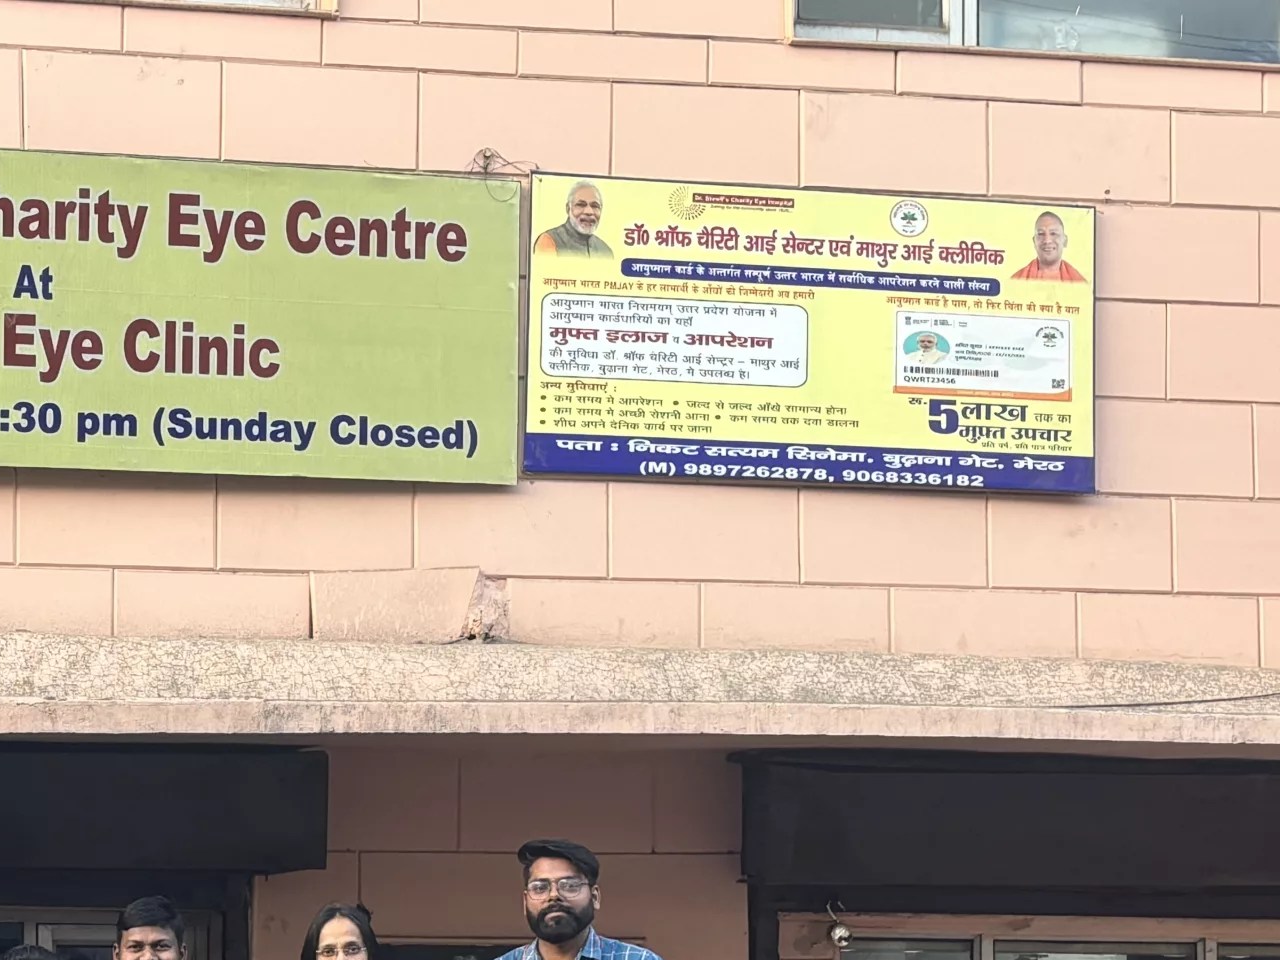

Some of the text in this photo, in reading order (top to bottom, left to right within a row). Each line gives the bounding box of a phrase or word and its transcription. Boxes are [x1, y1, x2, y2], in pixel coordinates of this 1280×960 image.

[168, 193, 265, 263] Eye
[286, 200, 467, 262] Centre
[654, 224, 692, 247] श्रॉफ
[696, 225, 740, 251] चैरिटी
[743, 229, 777, 255] आई
[781, 230, 826, 256] सेन्टर
[827, 234, 854, 257] एवं
[855, 241, 898, 268] माथुर
[900, 241, 934, 264] आई
[938, 240, 1005, 265] क्लीनिक
[13, 265, 53, 300] At
[579, 279, 601, 288] भारत
[646, 283, 657, 292] हर
[631, 263, 672, 276] आयुष्मान
[674, 264, 694, 275] कार्ड
[695, 264, 705, 275] के
[708, 266, 741, 278] अन्तर्गत
[800, 272, 824, 282] भारत
[827, 271, 836, 282] में
[877, 275, 917, 287] आपरेशन
[918, 277, 940, 288] करने
[942, 278, 965, 289] वाली
[967, 279, 990, 291] संस्था
[549, 298, 594, 311] आयुष्मान
[598, 300, 624, 310] भारत
[702, 304, 729, 315] प्रदेश
[732, 305, 765, 317] योजना
[549, 311, 594, 324] आयुष्मान
[656, 316, 670, 326] का
[4, 313, 103, 383] Eye
[124, 319, 280, 378] Clinic
[604, 329, 669, 344] इलाज
[683, 331, 774, 349] आपरेशन
[548, 346, 563, 357] की
[681, 352, 702, 365] आई
[749, 358, 776, 370] माथुर
[779, 357, 800, 370] आई
[539, 381, 562, 390] अन्य
[903, 375, 956, 384] QWRT23456
[553, 394, 572, 403] कम
[575, 395, 602, 404] समय
[618, 395, 663, 407] आपरेशन
[825, 404, 847, 415] होना
[552, 407, 572, 415] कम
[575, 407, 602, 416] समय
[685, 412, 709, 421] आना
[729, 414, 748, 423] कम
[751, 415, 777, 424] समय
[825, 418, 859, 428] डालना
[928, 398, 959, 434] 5
[960, 401, 1028, 422] लाख
[1033, 412, 1053, 423] तक
[1056, 414, 1071, 424] का
[77, 412, 137, 442] pm
[153, 407, 316, 451] (Sunday
[330, 415, 477, 458] Closed)
[669, 424, 683, 432] पर
[686, 425, 712, 433] जाना
[1010, 427, 1072, 442] उपचार
[555, 439, 603, 451] पता
[627, 438, 700, 455] निकट
[704, 445, 780, 458] सत्यम
[1013, 456, 1065, 471] मेरठ
[639, 461, 984, 487] (M) 9897262878, 9068336182
